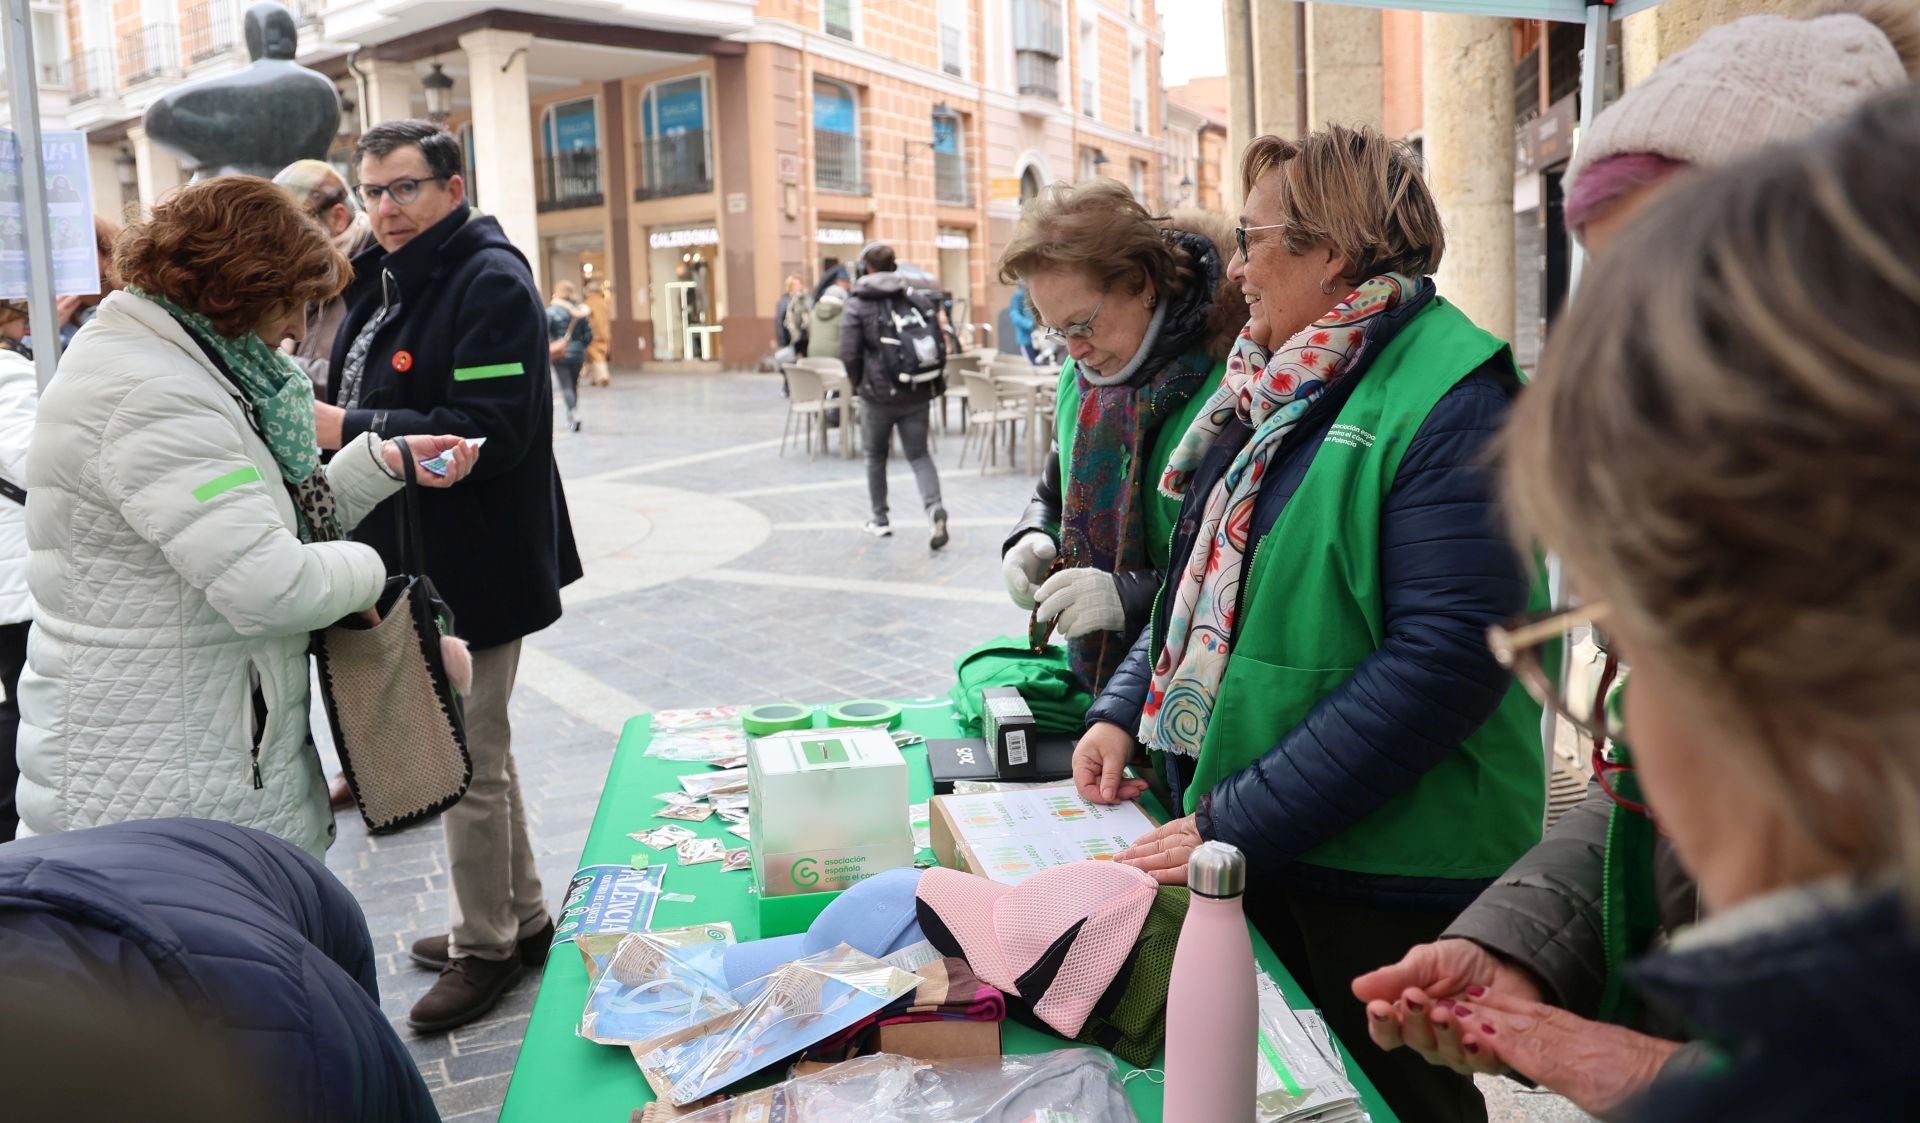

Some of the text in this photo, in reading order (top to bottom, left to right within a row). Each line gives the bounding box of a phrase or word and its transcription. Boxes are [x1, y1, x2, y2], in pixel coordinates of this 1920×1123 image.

[1331, 424, 1360, 432] sociación
[824, 855, 866, 866] asociación
[824, 864, 861, 875] española
[824, 874, 851, 883] contra
